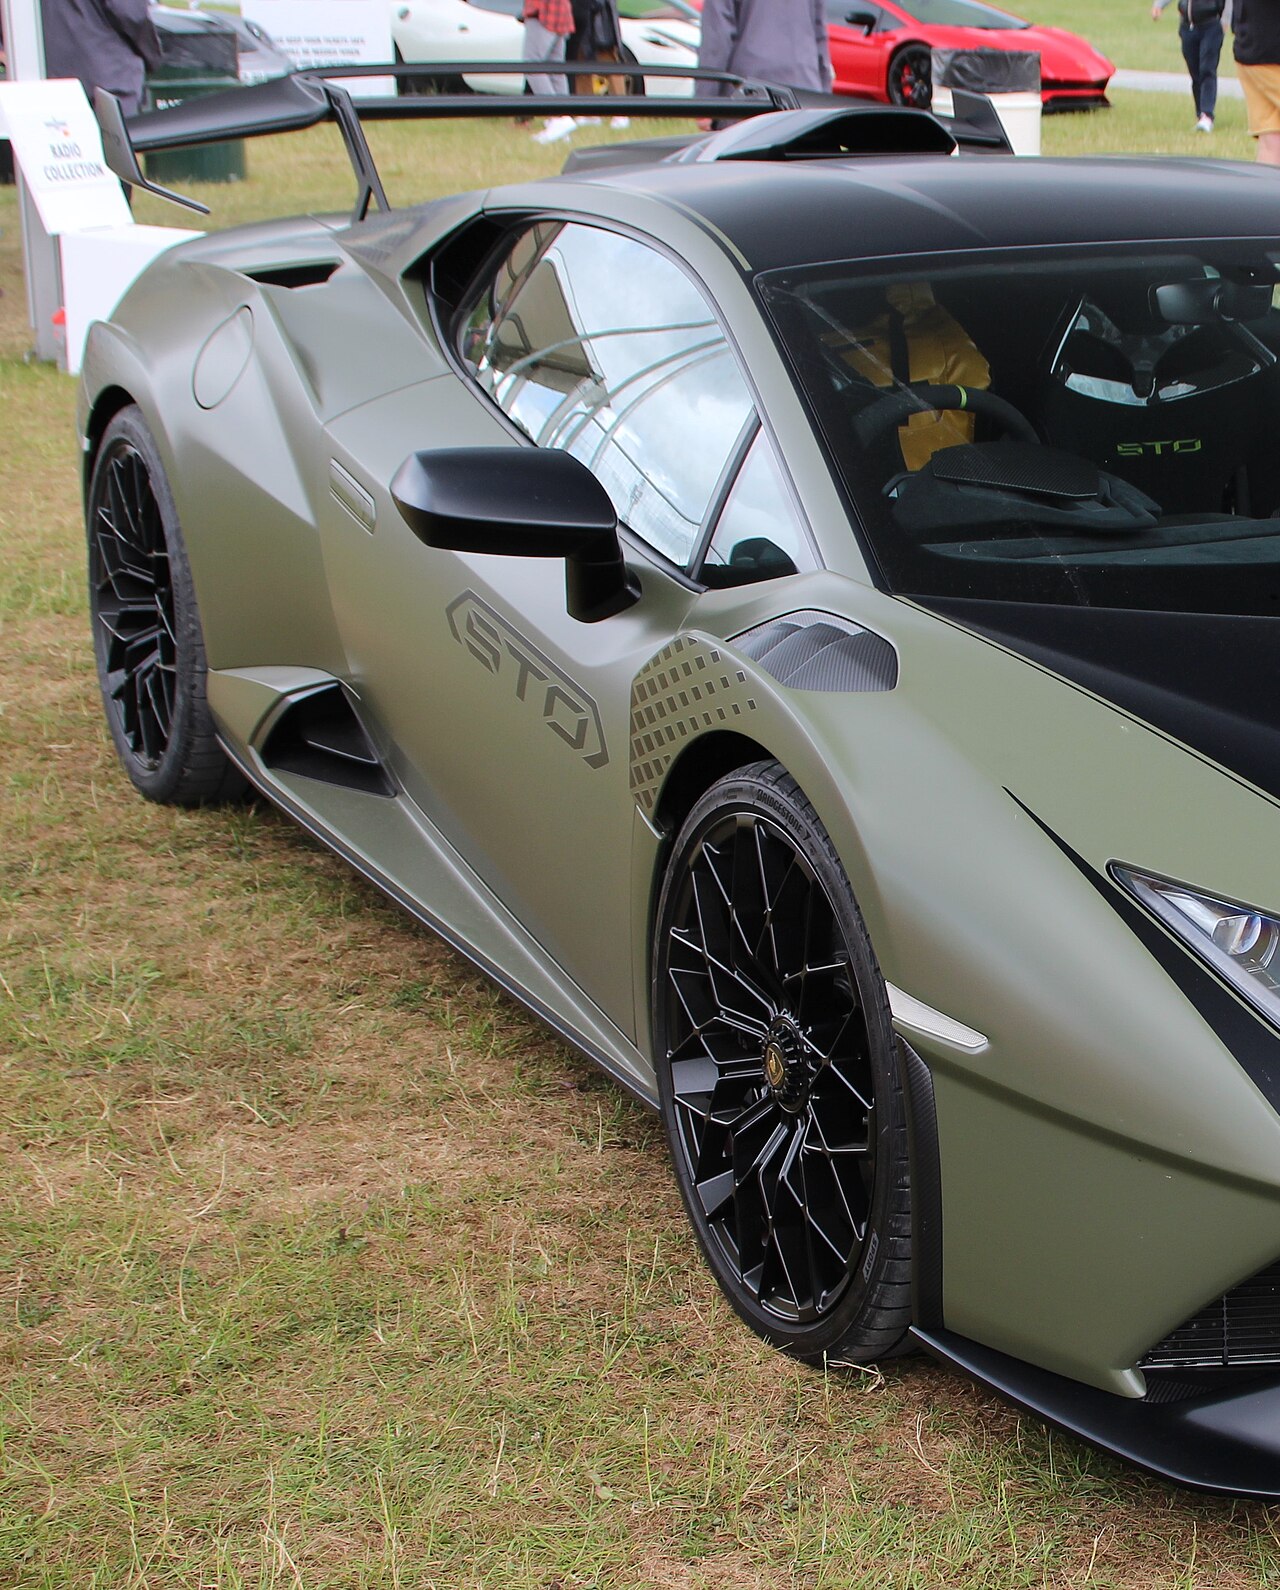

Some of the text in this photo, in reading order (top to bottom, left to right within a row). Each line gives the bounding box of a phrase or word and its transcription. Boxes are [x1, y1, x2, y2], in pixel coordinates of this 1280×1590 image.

[50, 143, 82, 158] RADIO
[44, 161, 104, 181] COLLECTION
[1117, 438, 1202, 456] STO
[464, 608, 589, 750] STO
[756, 788, 803, 835] BRIDGESTONE
